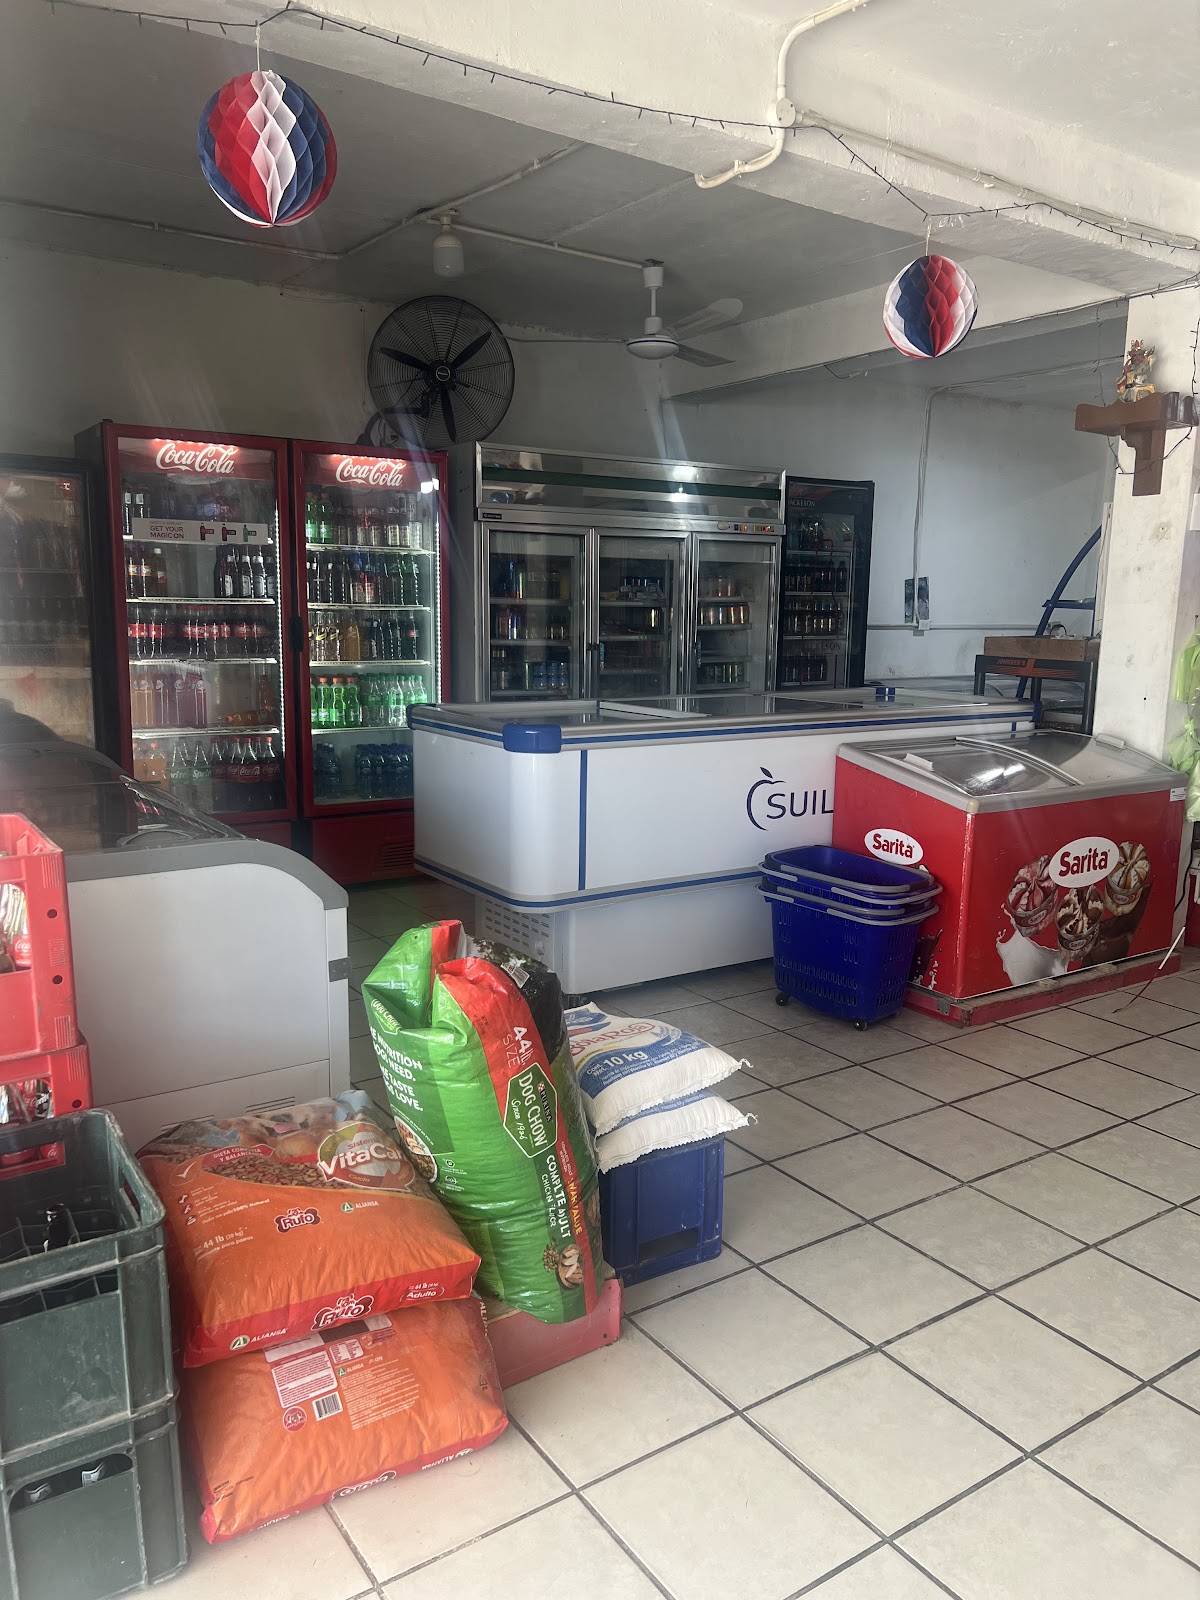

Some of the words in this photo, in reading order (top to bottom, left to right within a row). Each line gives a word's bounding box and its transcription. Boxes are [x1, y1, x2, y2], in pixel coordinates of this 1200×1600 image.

[155, 442, 239, 474] Coca-Cola
[336, 458, 407, 487] Coca-Cola
[872, 833, 914, 859] Sarita
[1058, 847, 1110, 877] Sarita
[502, 1034, 521, 1069] SIZE
[602, 1056, 625, 1068] 10
[623, 1050, 649, 1061] kg
[388, 1058, 417, 1082] NEED.
[518, 1071, 537, 1107] DOG
[395, 1090, 424, 1112] LOVE.
[511, 1098, 522, 1120] Since
[540, 1090, 553, 1122] PURINA
[527, 1105, 548, 1147] CHOW
[213, 1149, 231, 1159] DIETA
[545, 1154, 567, 1207] COMPLTE
[233, 1204, 249, 1213] 100%
[249, 1198, 270, 1209] Natural
[355, 1200, 379, 1209] ALIANSA
[281, 1212, 315, 1230] Rufo
[203, 1239, 214, 1250] 44
[215, 1234, 225, 1243] lb
[406, 1290, 437, 1299] Adulto
[250, 1328, 287, 1344] ALIANSA
